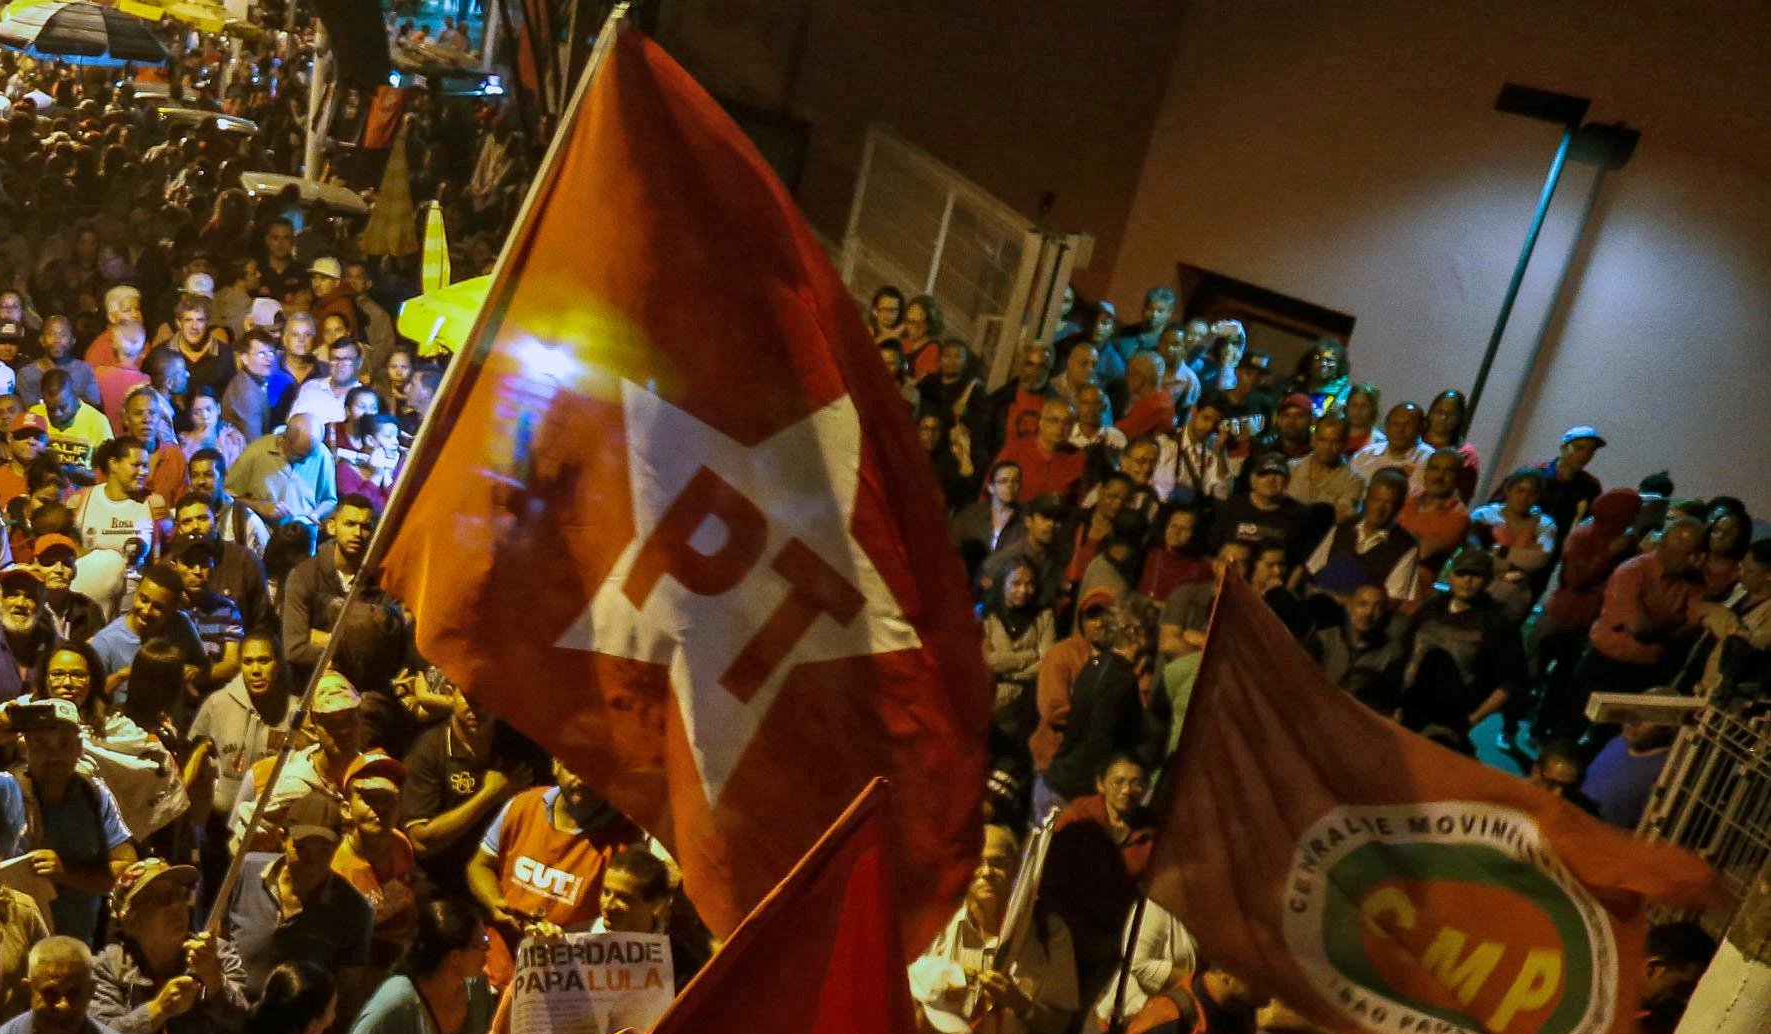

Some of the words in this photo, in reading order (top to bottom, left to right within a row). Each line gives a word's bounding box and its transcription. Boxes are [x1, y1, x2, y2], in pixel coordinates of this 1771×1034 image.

[623, 464, 868, 705] PT
[515, 855, 576, 896] CUT
[514, 970, 585, 1000] PARA
[587, 967, 664, 991] LULA
[1360, 886, 1565, 1034] CMP
